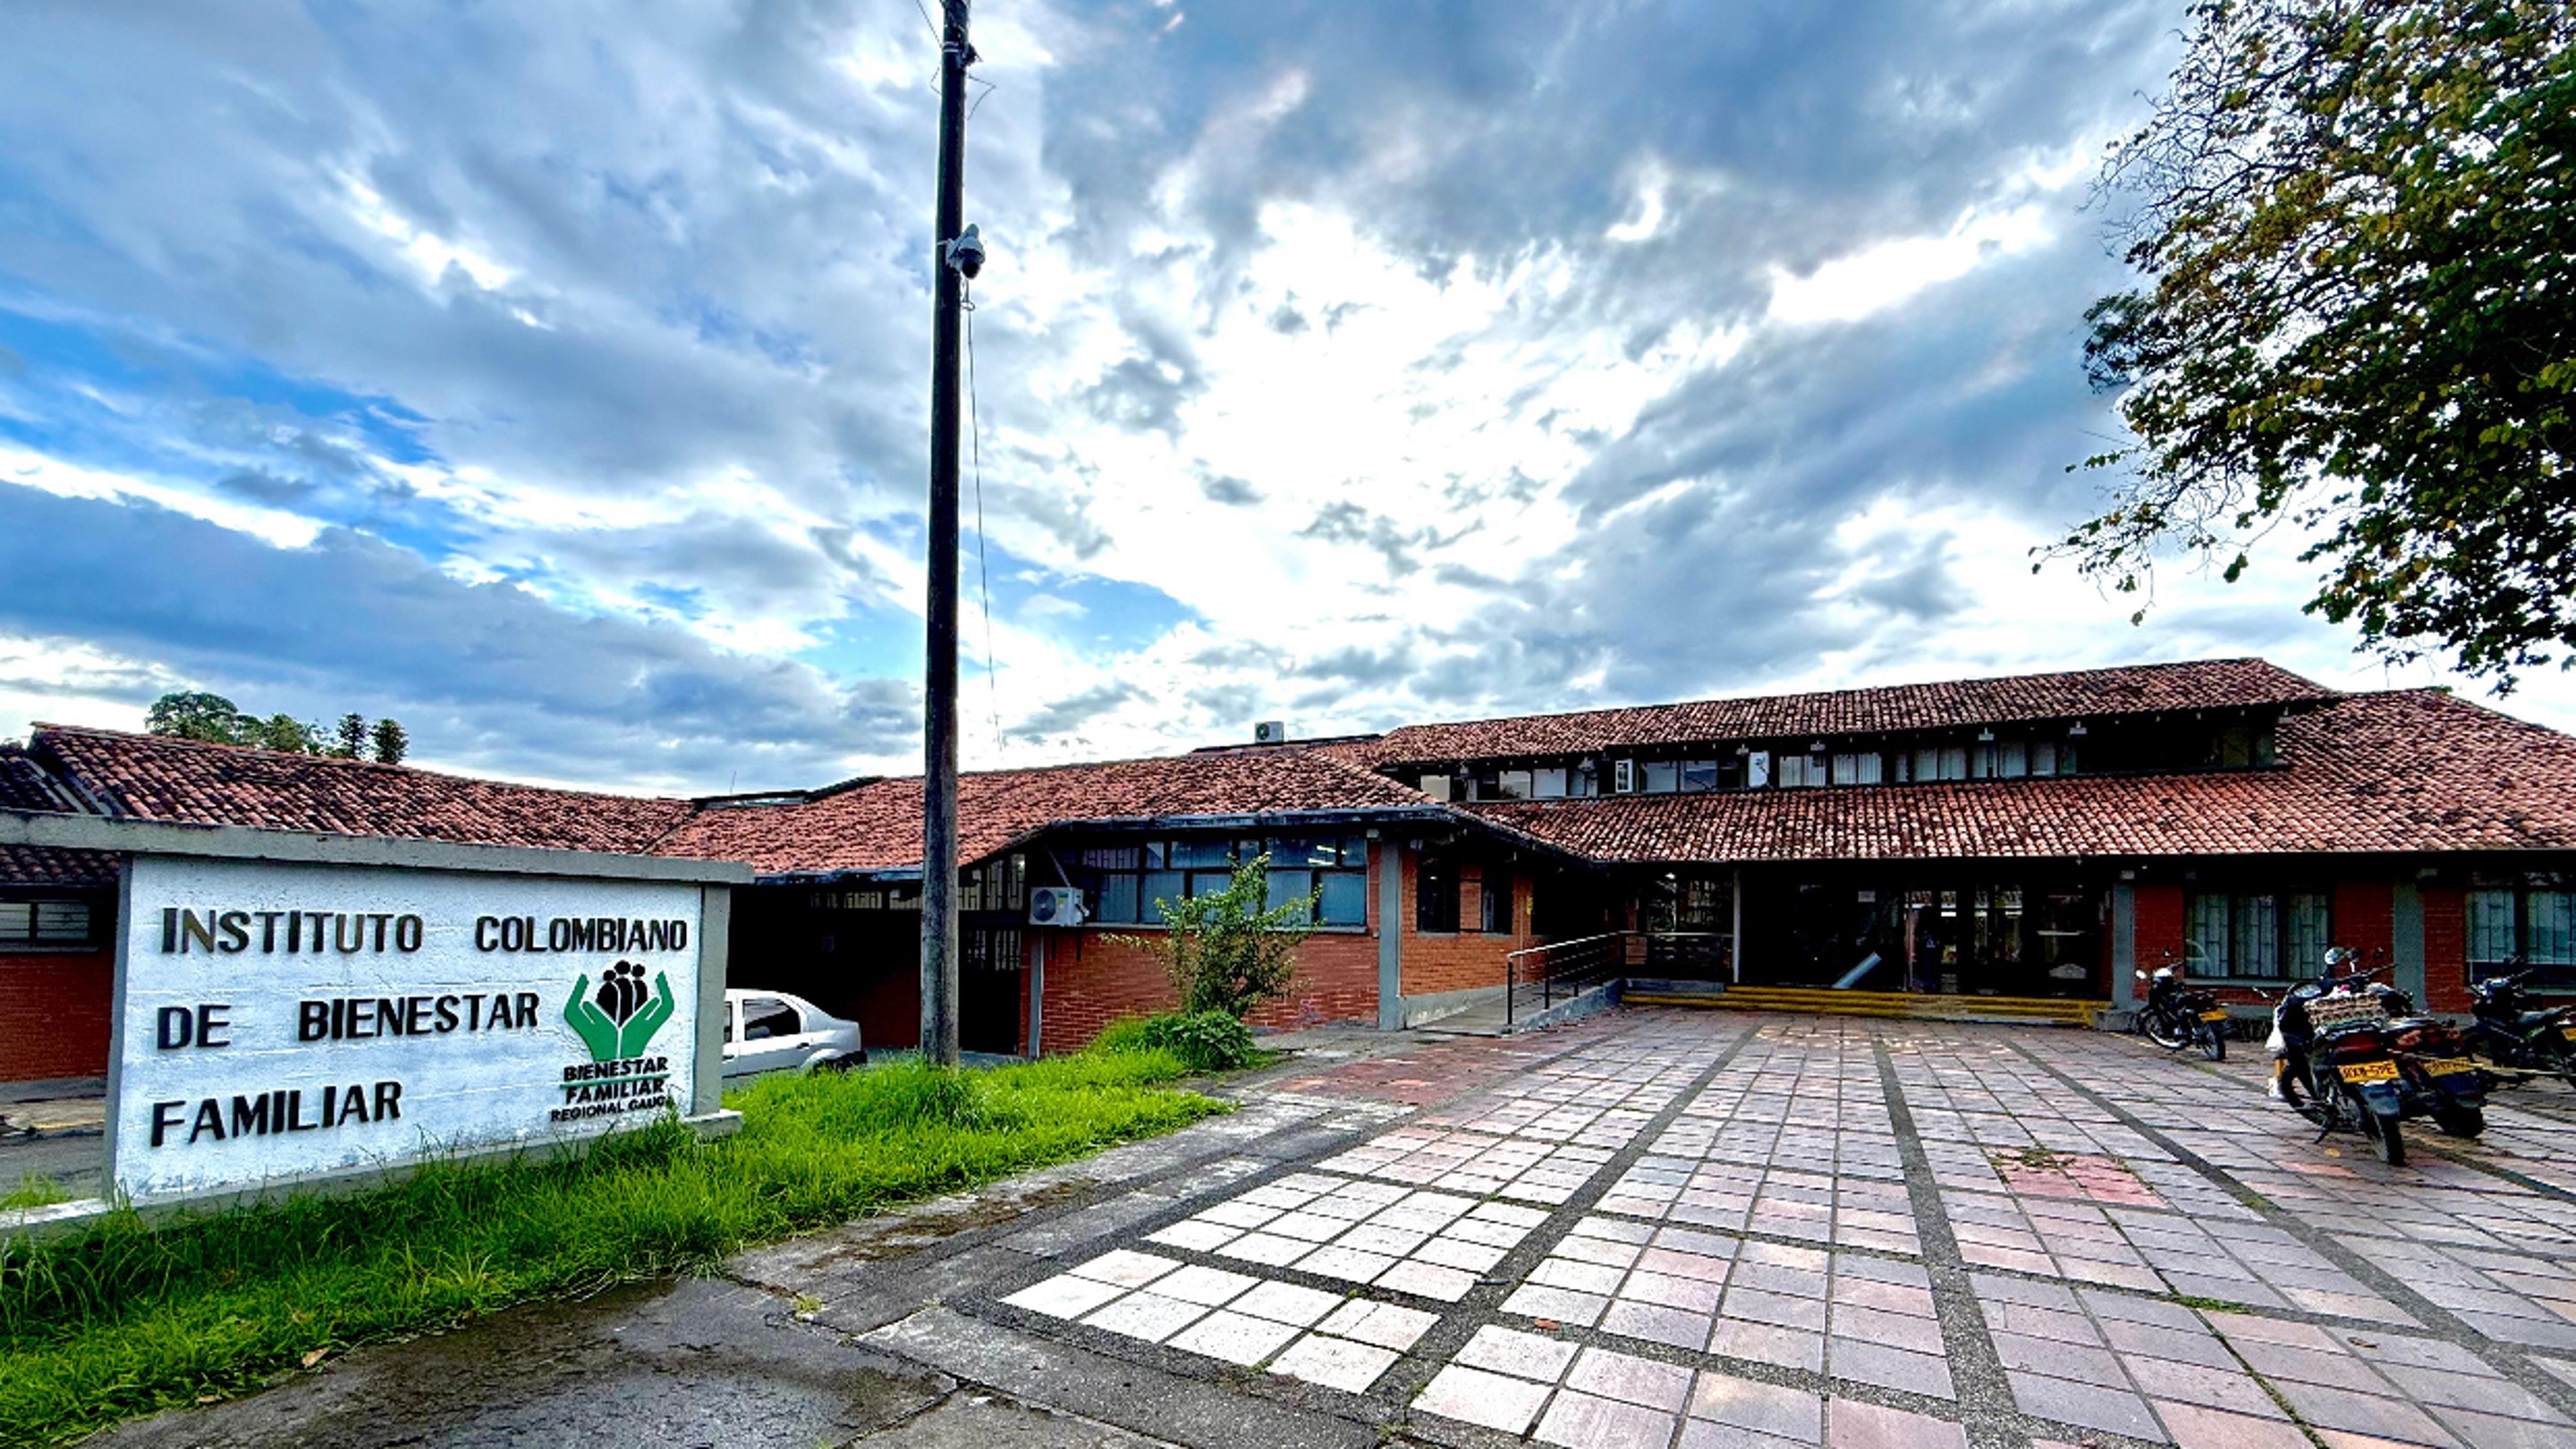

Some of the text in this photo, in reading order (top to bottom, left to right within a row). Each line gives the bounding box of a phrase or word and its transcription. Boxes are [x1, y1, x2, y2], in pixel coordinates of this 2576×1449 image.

[161, 907, 687, 954] INSTITUTO COLOMBIANO
[157, 992, 539, 1051] DE BIENESTAR
[564, 1056, 668, 1082] BIENESTAR
[551, 1095, 673, 1122] REGIONAL CAUC
[565, 1078, 665, 1105] FAMILIAR
[150, 1081, 402, 1148] FAMILIAR
